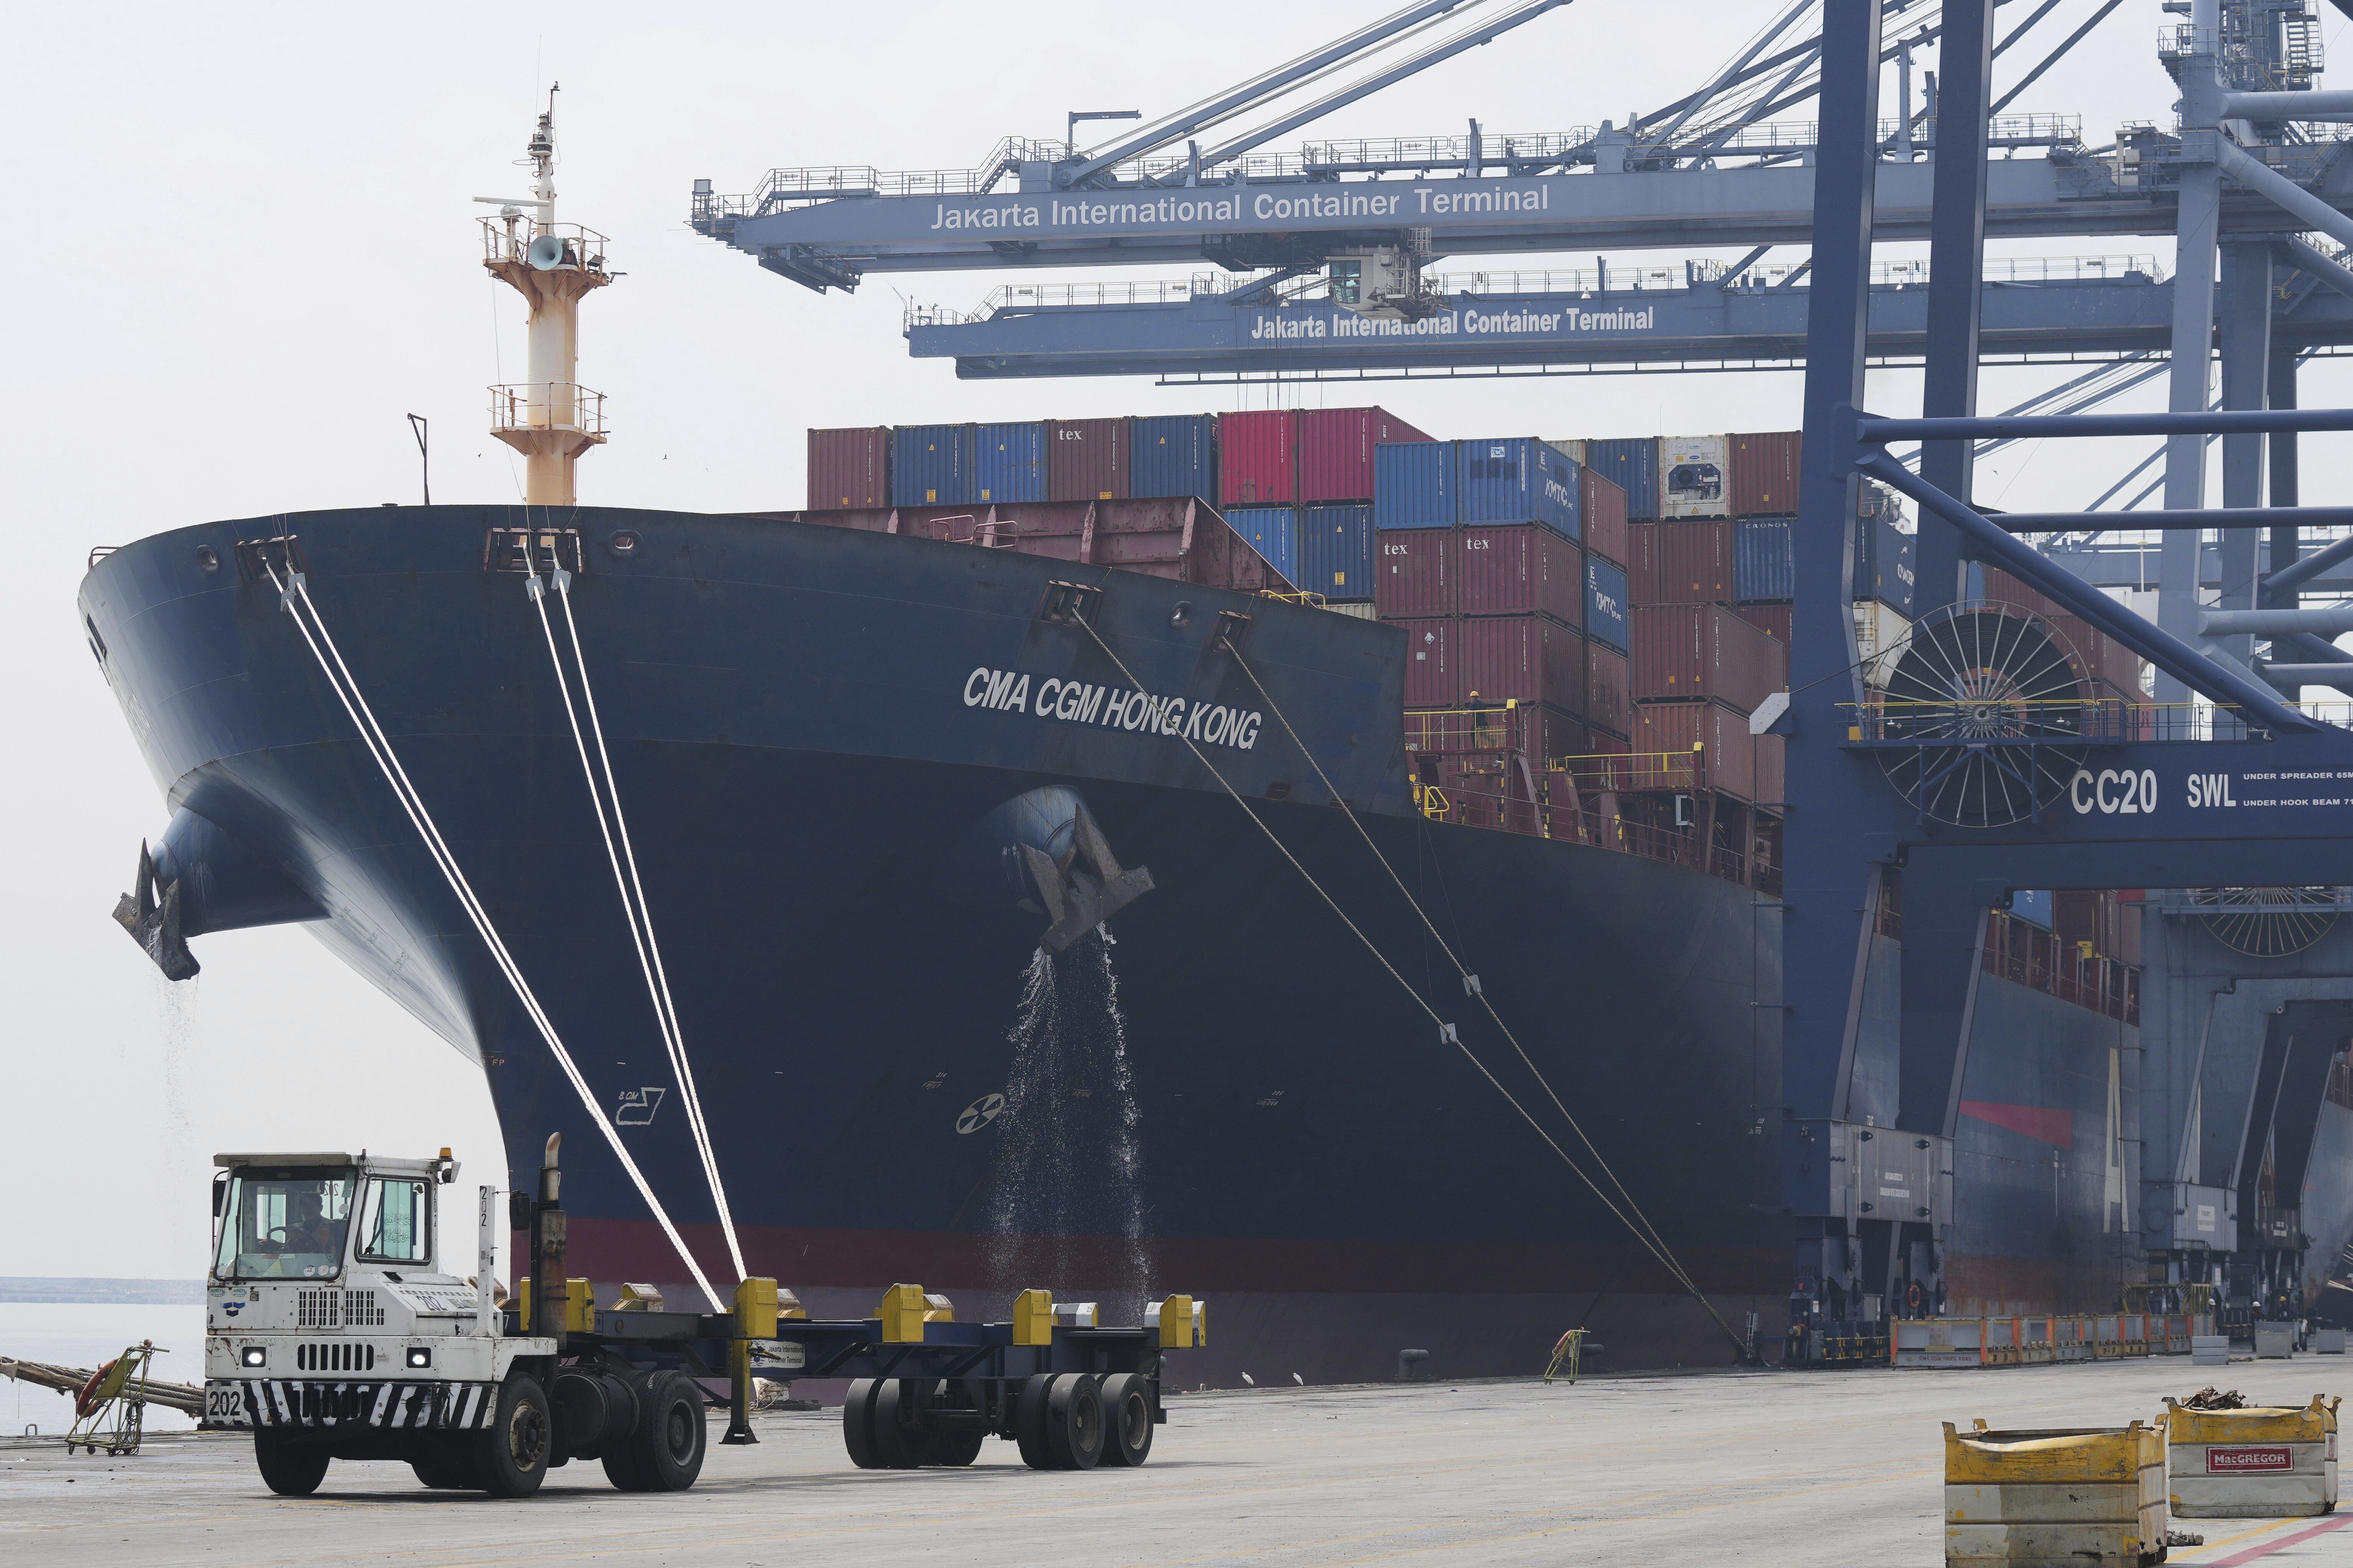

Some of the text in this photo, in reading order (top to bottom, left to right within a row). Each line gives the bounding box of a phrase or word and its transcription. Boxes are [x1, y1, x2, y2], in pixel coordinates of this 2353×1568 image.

[1052, 195, 1240, 225] International
[1255, 191, 1400, 219] Container
[1414, 184, 1548, 214] Terminal
[1252, 315, 1326, 339] Jakarta
[1464, 308, 1560, 334] Container
[1566, 306, 1653, 331] Terminal
[1059, 428, 1082, 440] tex
[1384, 542, 1408, 555] tex
[1466, 538, 1489, 550] tex
[963, 667, 1262, 750] CMA CGM HONG KONG
[2072, 769, 2236, 814] CC20 SWL
[416, 1295, 448, 1311] 202
[209, 1391, 241, 1416] 202
[2214, 1453, 2286, 1464] MacGREGOR
